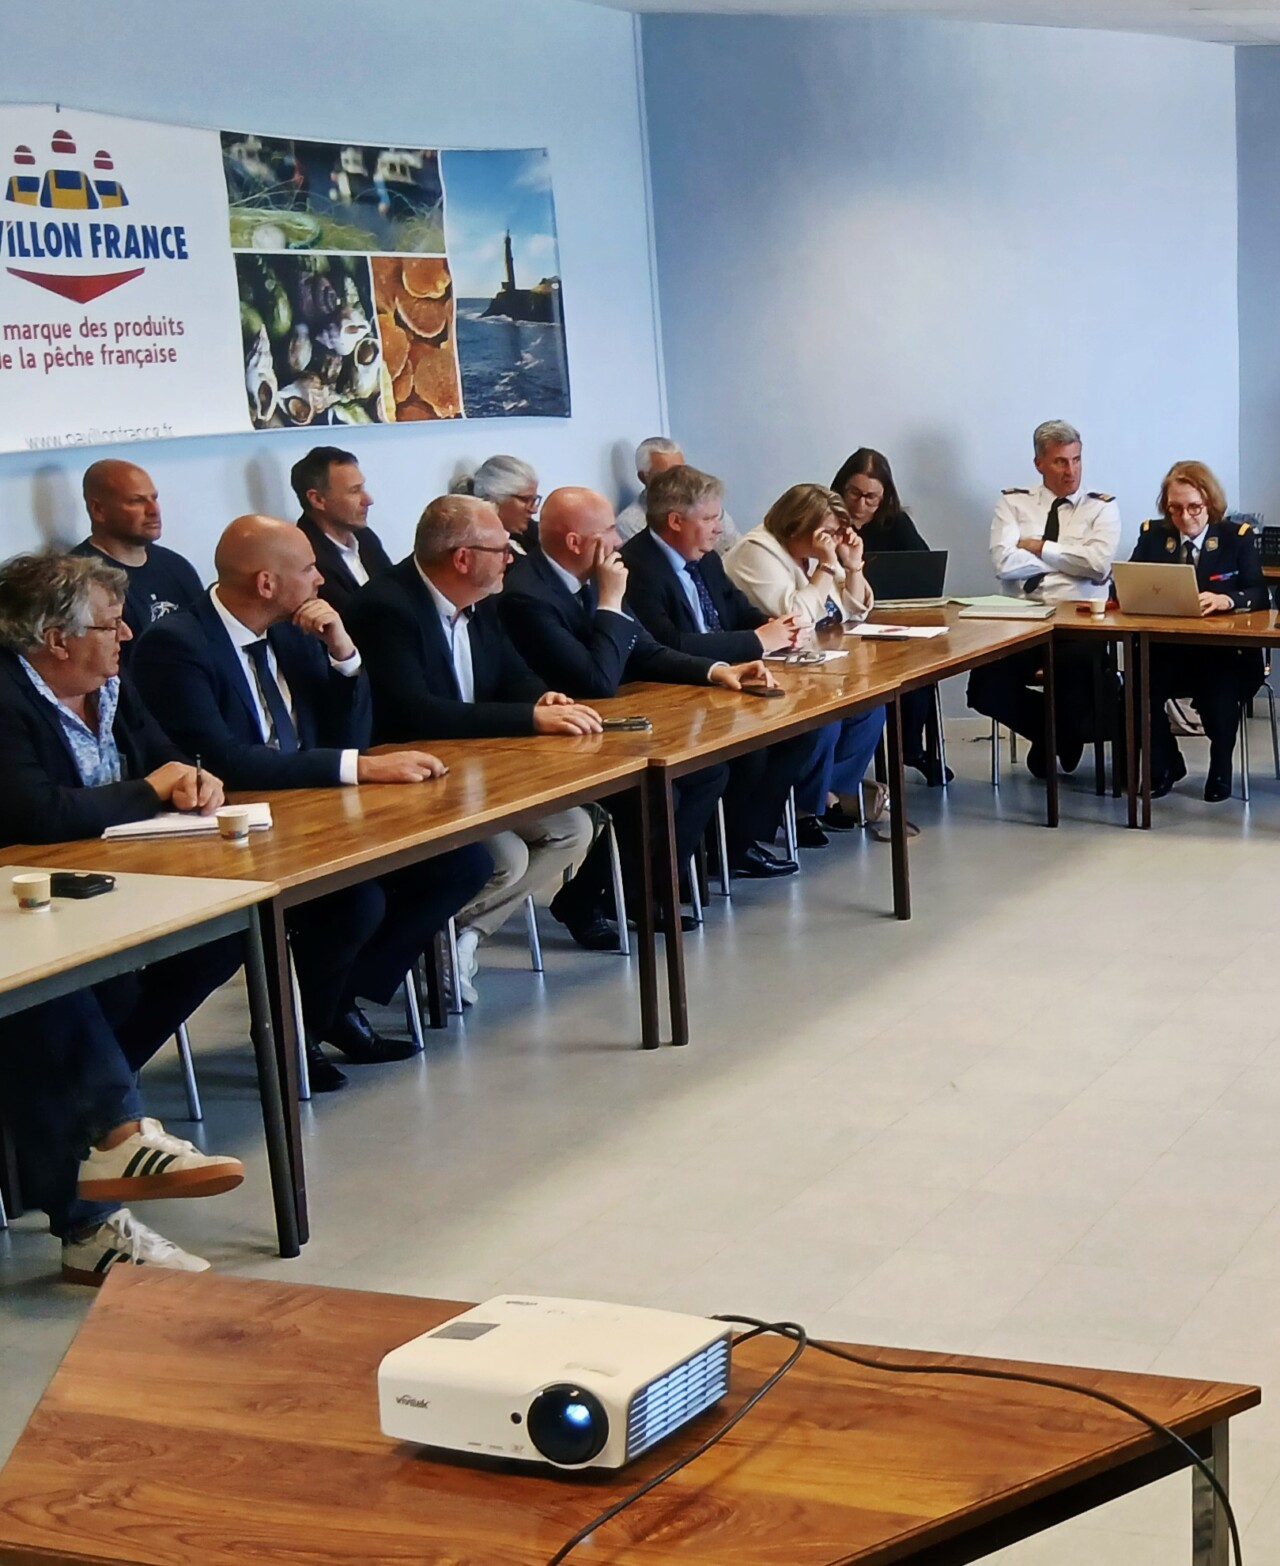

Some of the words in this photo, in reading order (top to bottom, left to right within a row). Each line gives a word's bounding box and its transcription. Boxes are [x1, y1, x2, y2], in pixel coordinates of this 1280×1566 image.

[89, 223, 189, 260] FRANCE
[3, 322, 72, 346] marque
[79, 316, 108, 339] des
[114, 315, 185, 343] produits
[19, 347, 37, 369] la
[43, 344, 94, 375] pêche
[100, 343, 177, 369] française
